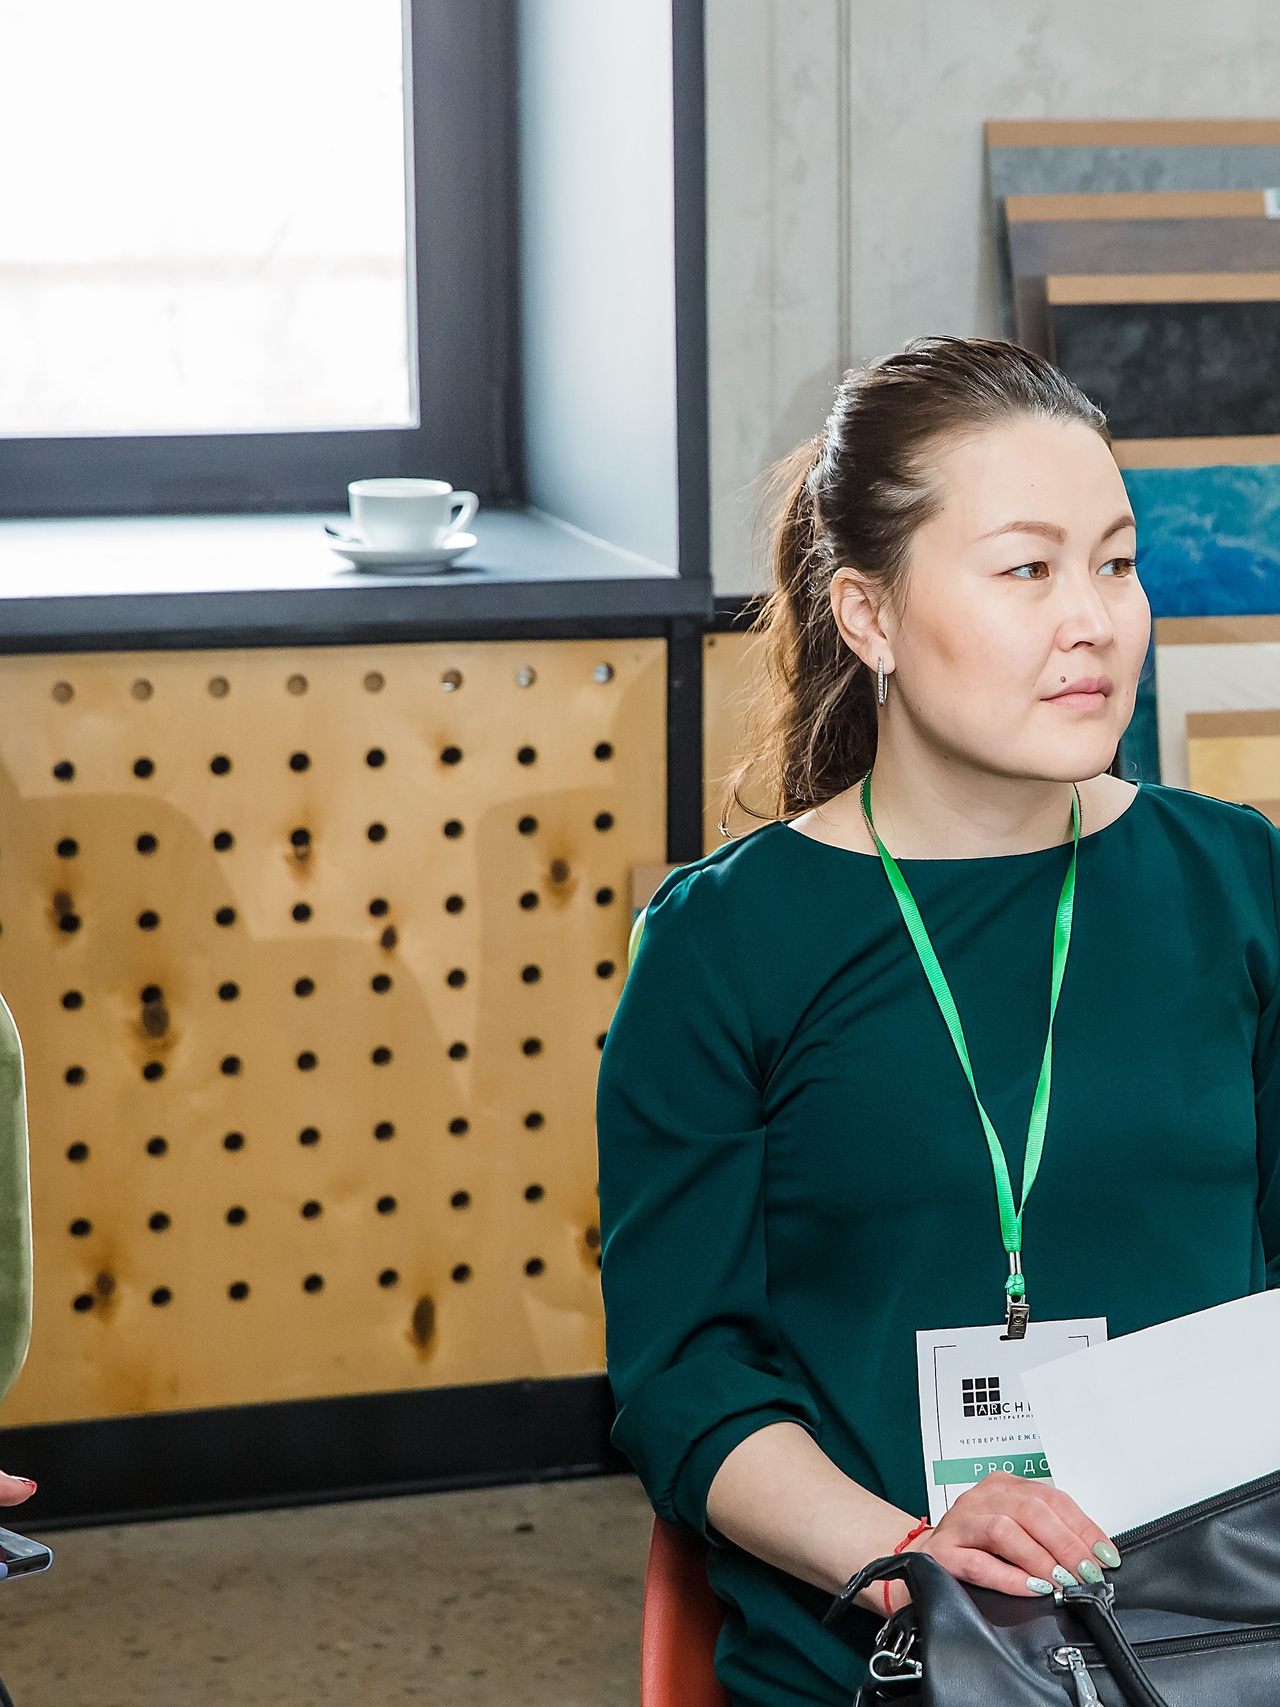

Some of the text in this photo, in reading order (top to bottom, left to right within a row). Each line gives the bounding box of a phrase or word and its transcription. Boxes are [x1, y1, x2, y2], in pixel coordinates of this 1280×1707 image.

[978, 1401, 1031, 1415] ARCHI
[959, 1433, 1041, 1445] ЧЕТВЕРТЫЙ ЕЖЕ
[974, 1458, 1050, 1476] PRO ДО
